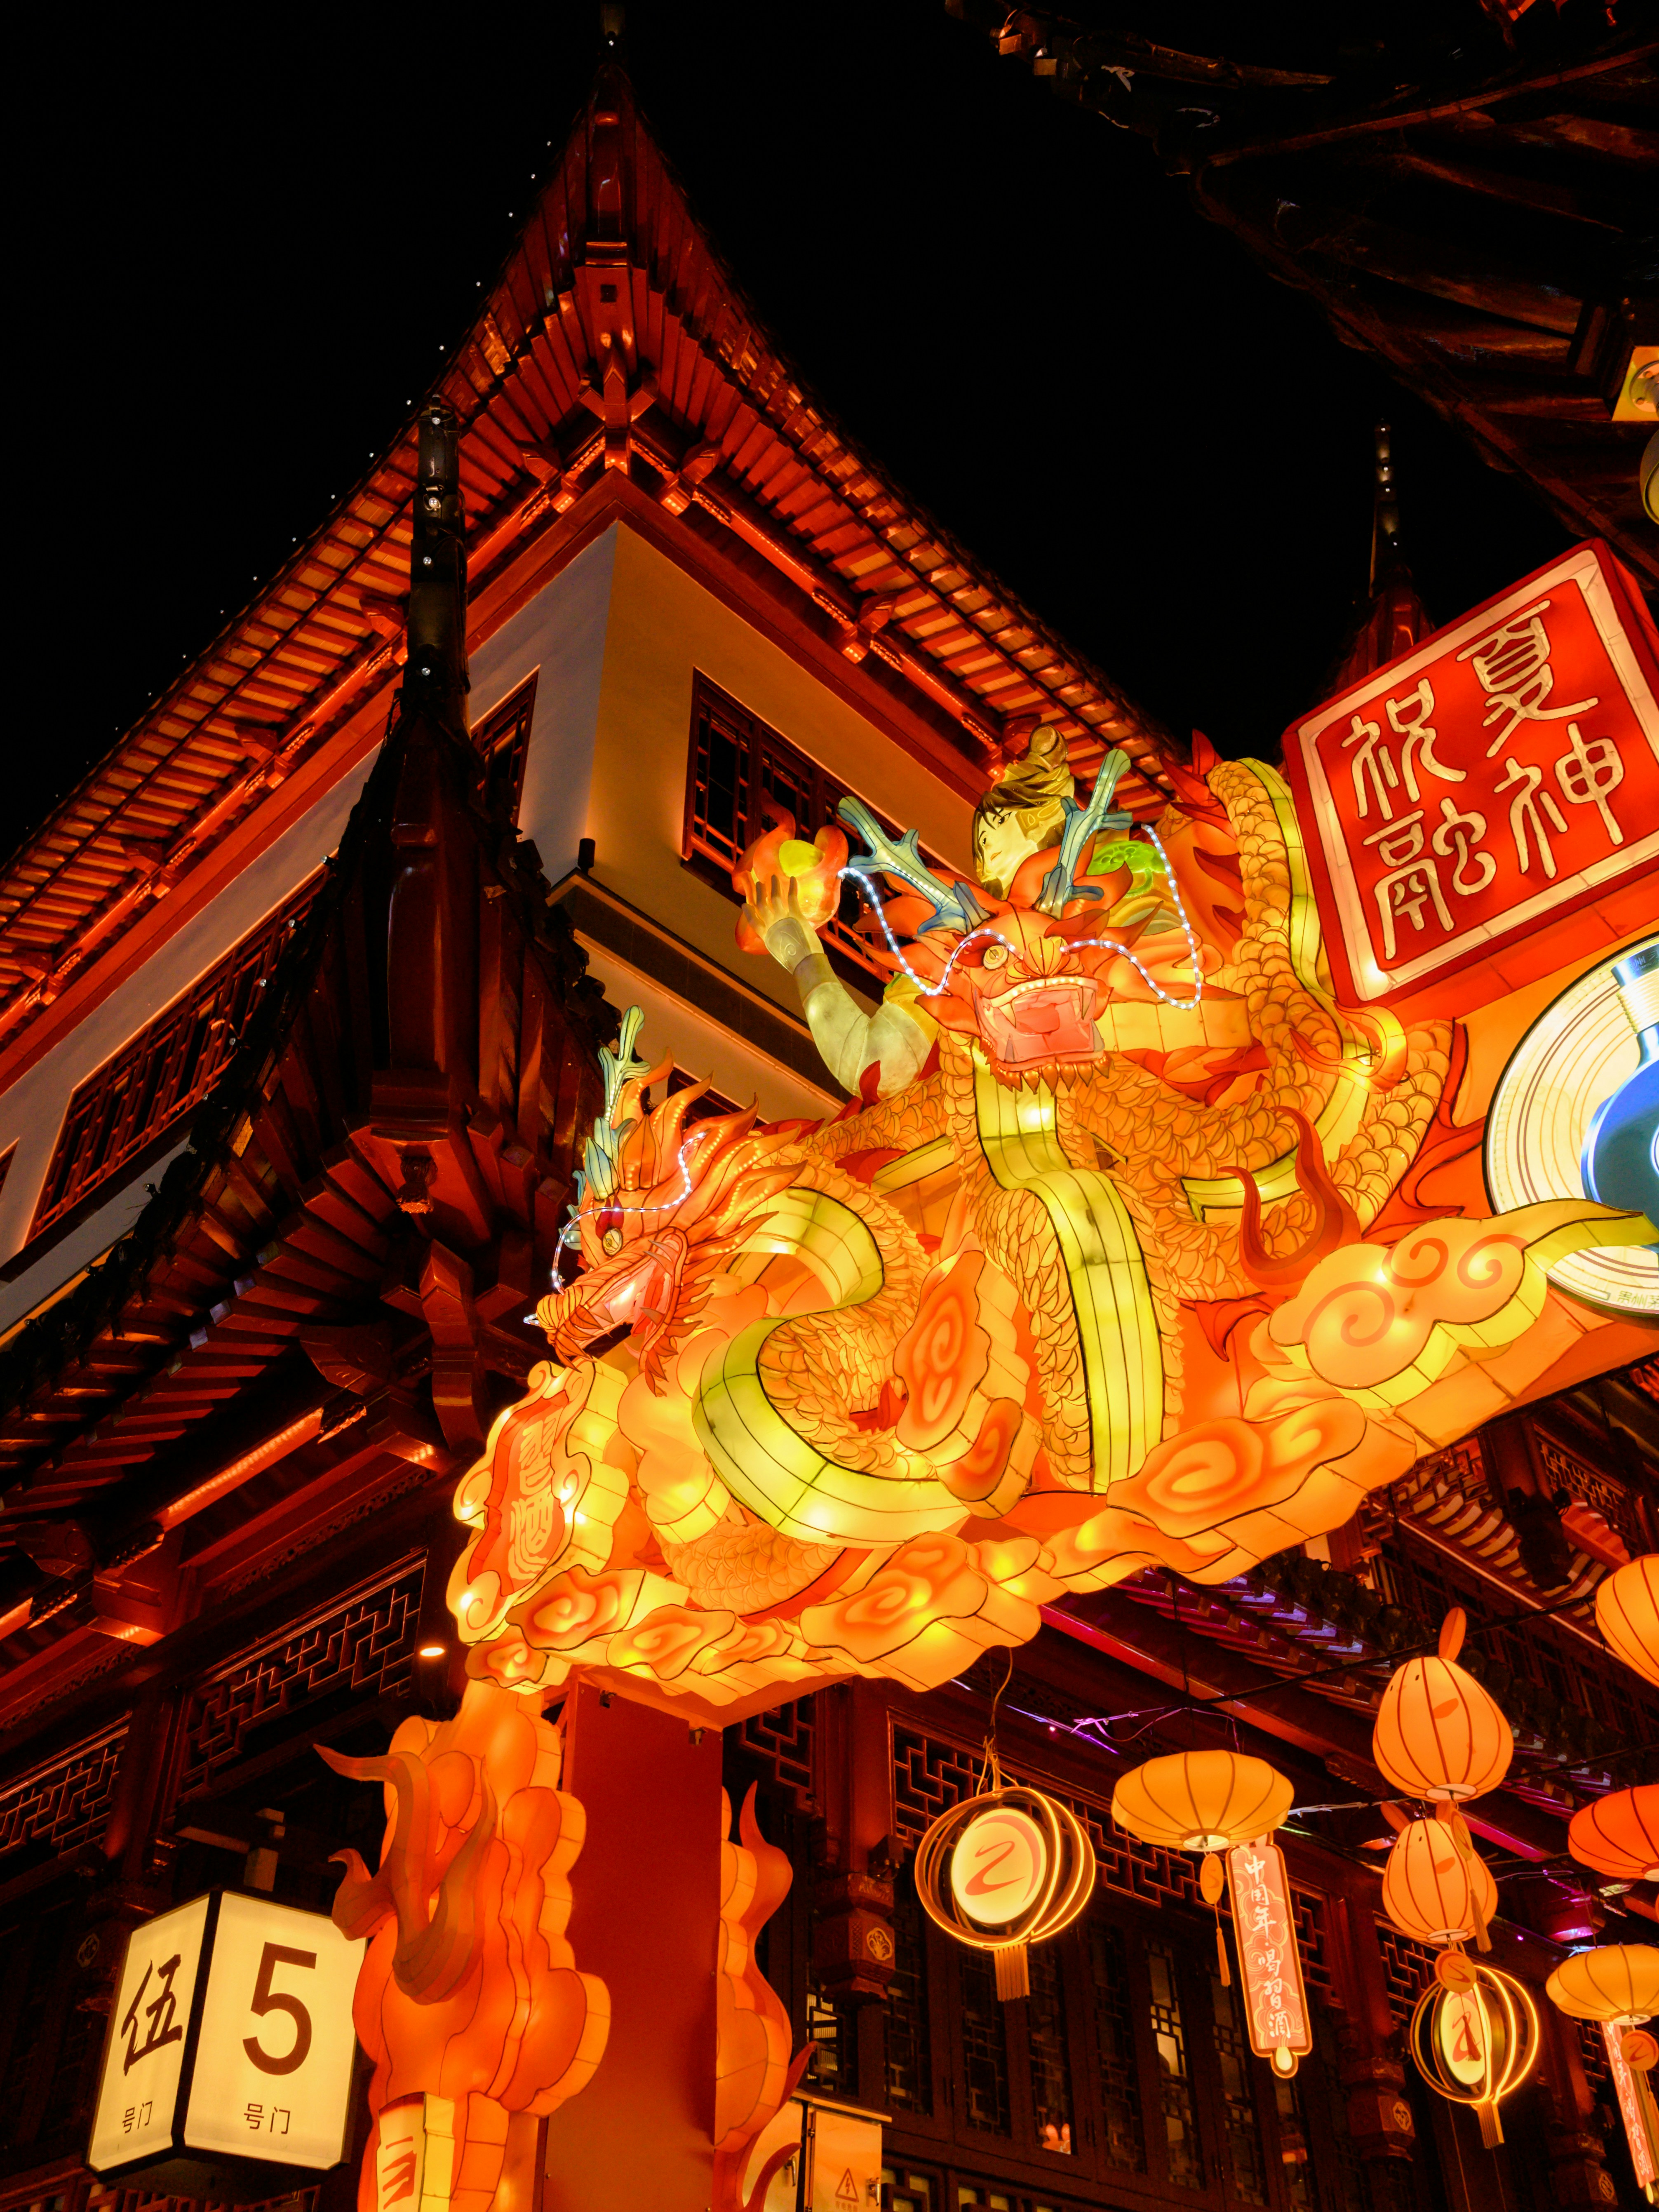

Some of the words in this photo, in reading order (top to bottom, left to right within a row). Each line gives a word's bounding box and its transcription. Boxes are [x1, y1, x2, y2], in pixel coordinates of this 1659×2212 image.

[121, 1953, 183, 2076] 伍
[242, 1941, 317, 2076] 5
[122, 2100, 153, 2134] 号门
[244, 2103, 291, 2134] 号门
